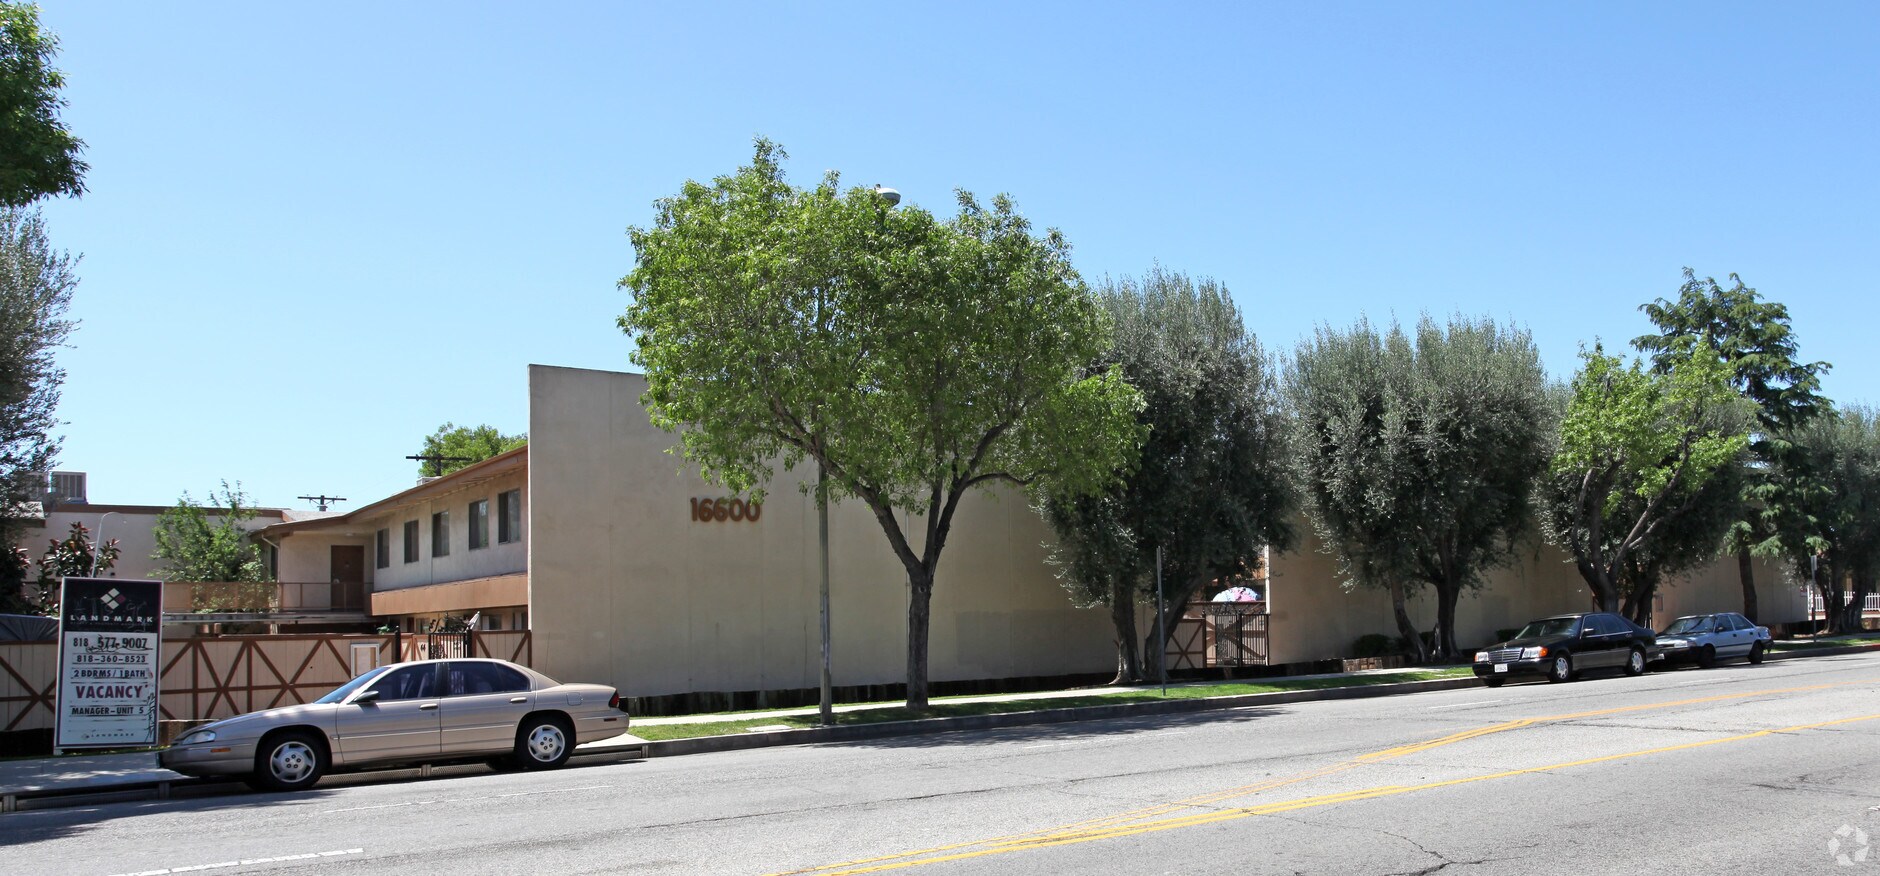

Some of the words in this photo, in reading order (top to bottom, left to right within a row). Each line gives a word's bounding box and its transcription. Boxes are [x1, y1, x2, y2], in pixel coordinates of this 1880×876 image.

[690, 497, 761, 522] 16600
[70, 614, 153, 622] LANDMARK
[73, 638, 89, 647] 818
[75, 685, 143, 698] VACANCY
